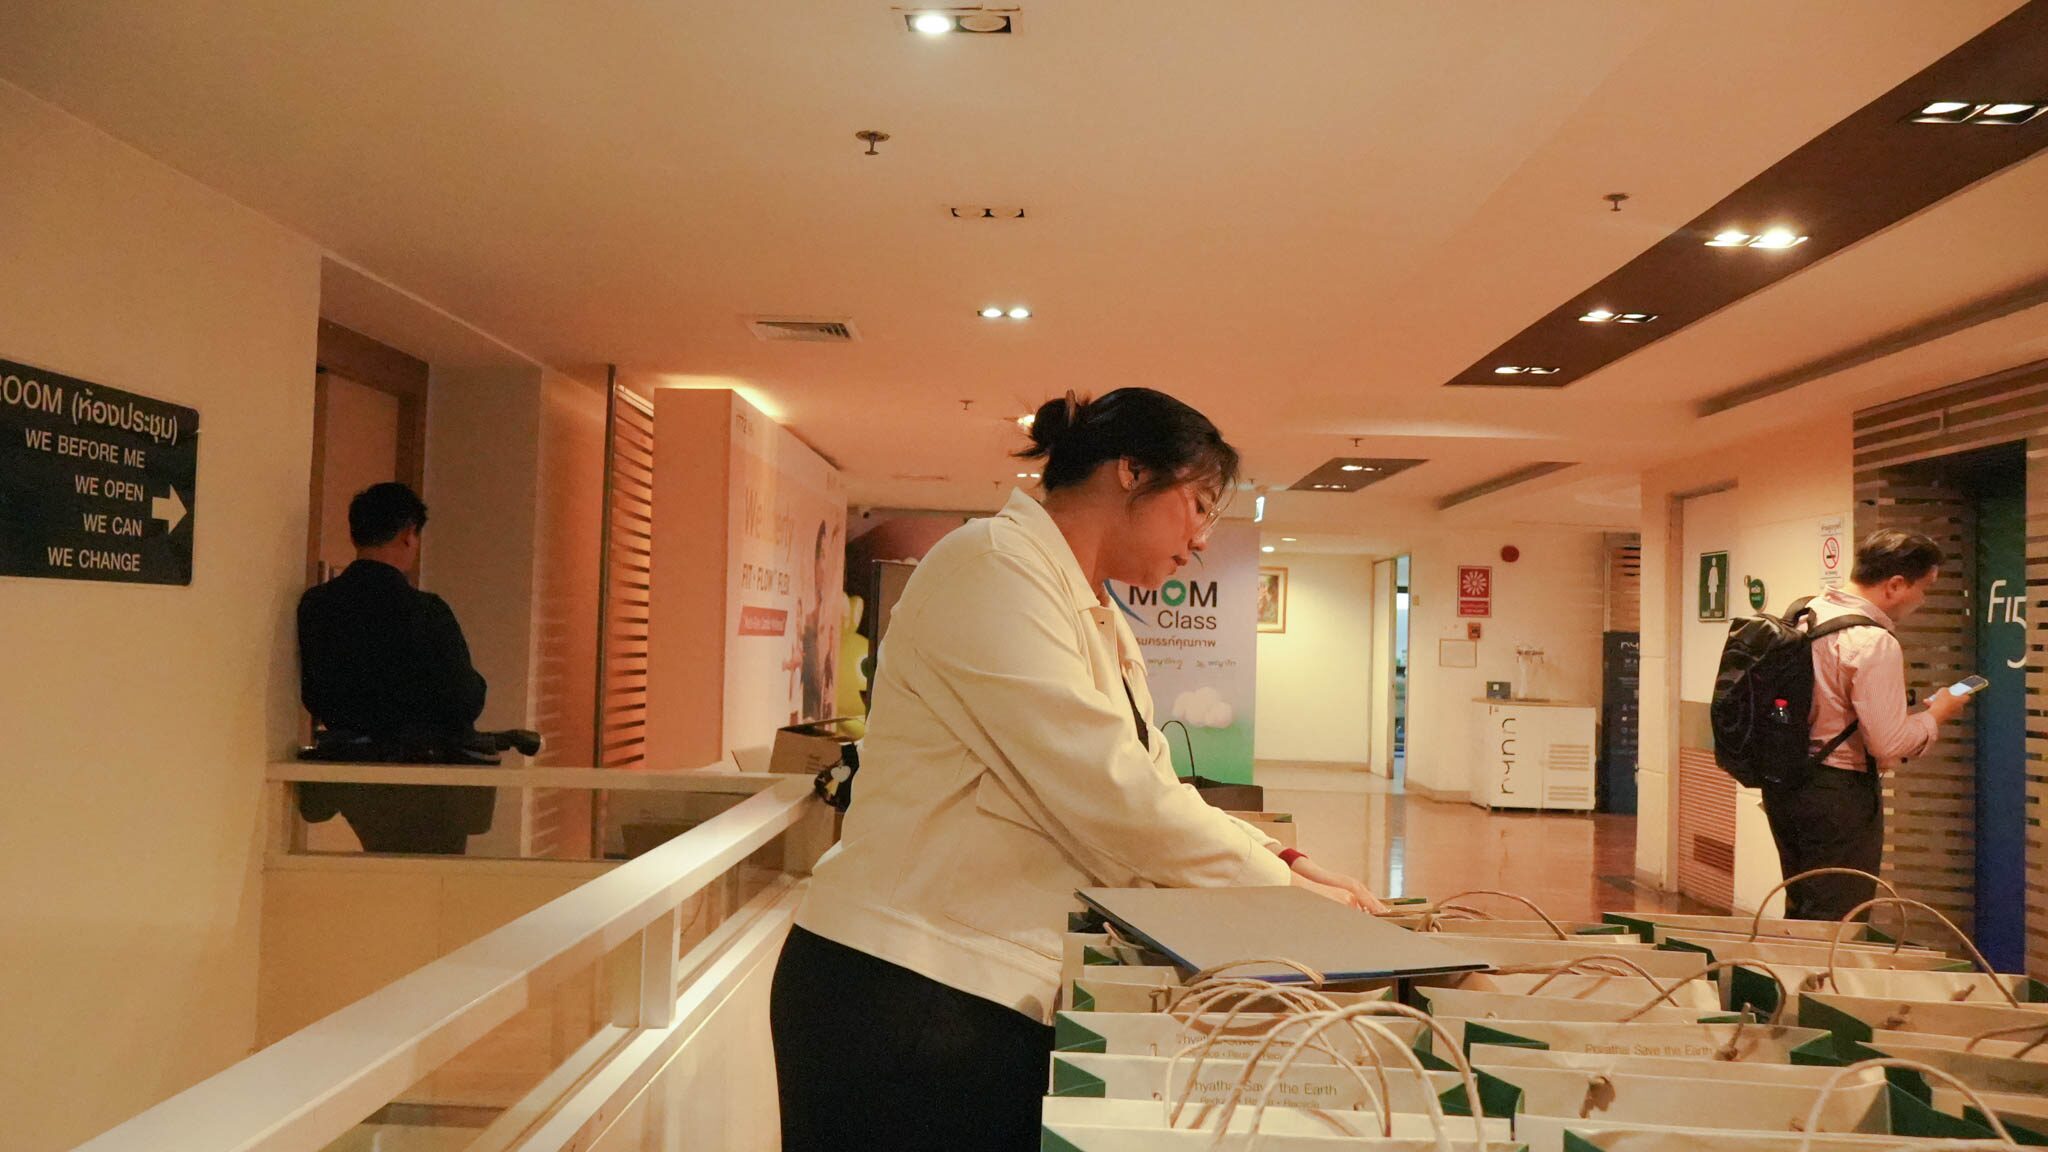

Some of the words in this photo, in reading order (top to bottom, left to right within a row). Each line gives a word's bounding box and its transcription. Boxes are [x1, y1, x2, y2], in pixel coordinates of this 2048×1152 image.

[0, 375, 62, 415] OOM
[25, 428, 52, 451] WE
[57, 436, 119, 463] BEFORE
[124, 448, 146, 469] ME
[75, 474, 99, 496] WE
[104, 479, 144, 501] OPEN
[83, 513, 107, 533] WE
[112, 516, 142, 537] CAN
[48, 547, 73, 567] WE
[79, 549, 141, 572] CHANGE
[1157, 609, 1217, 630] Class
[1685, 1045, 1713, 1057] Earth
[1280, 1083, 1299, 1095] the
[1304, 1083, 1337, 1096] Earth
